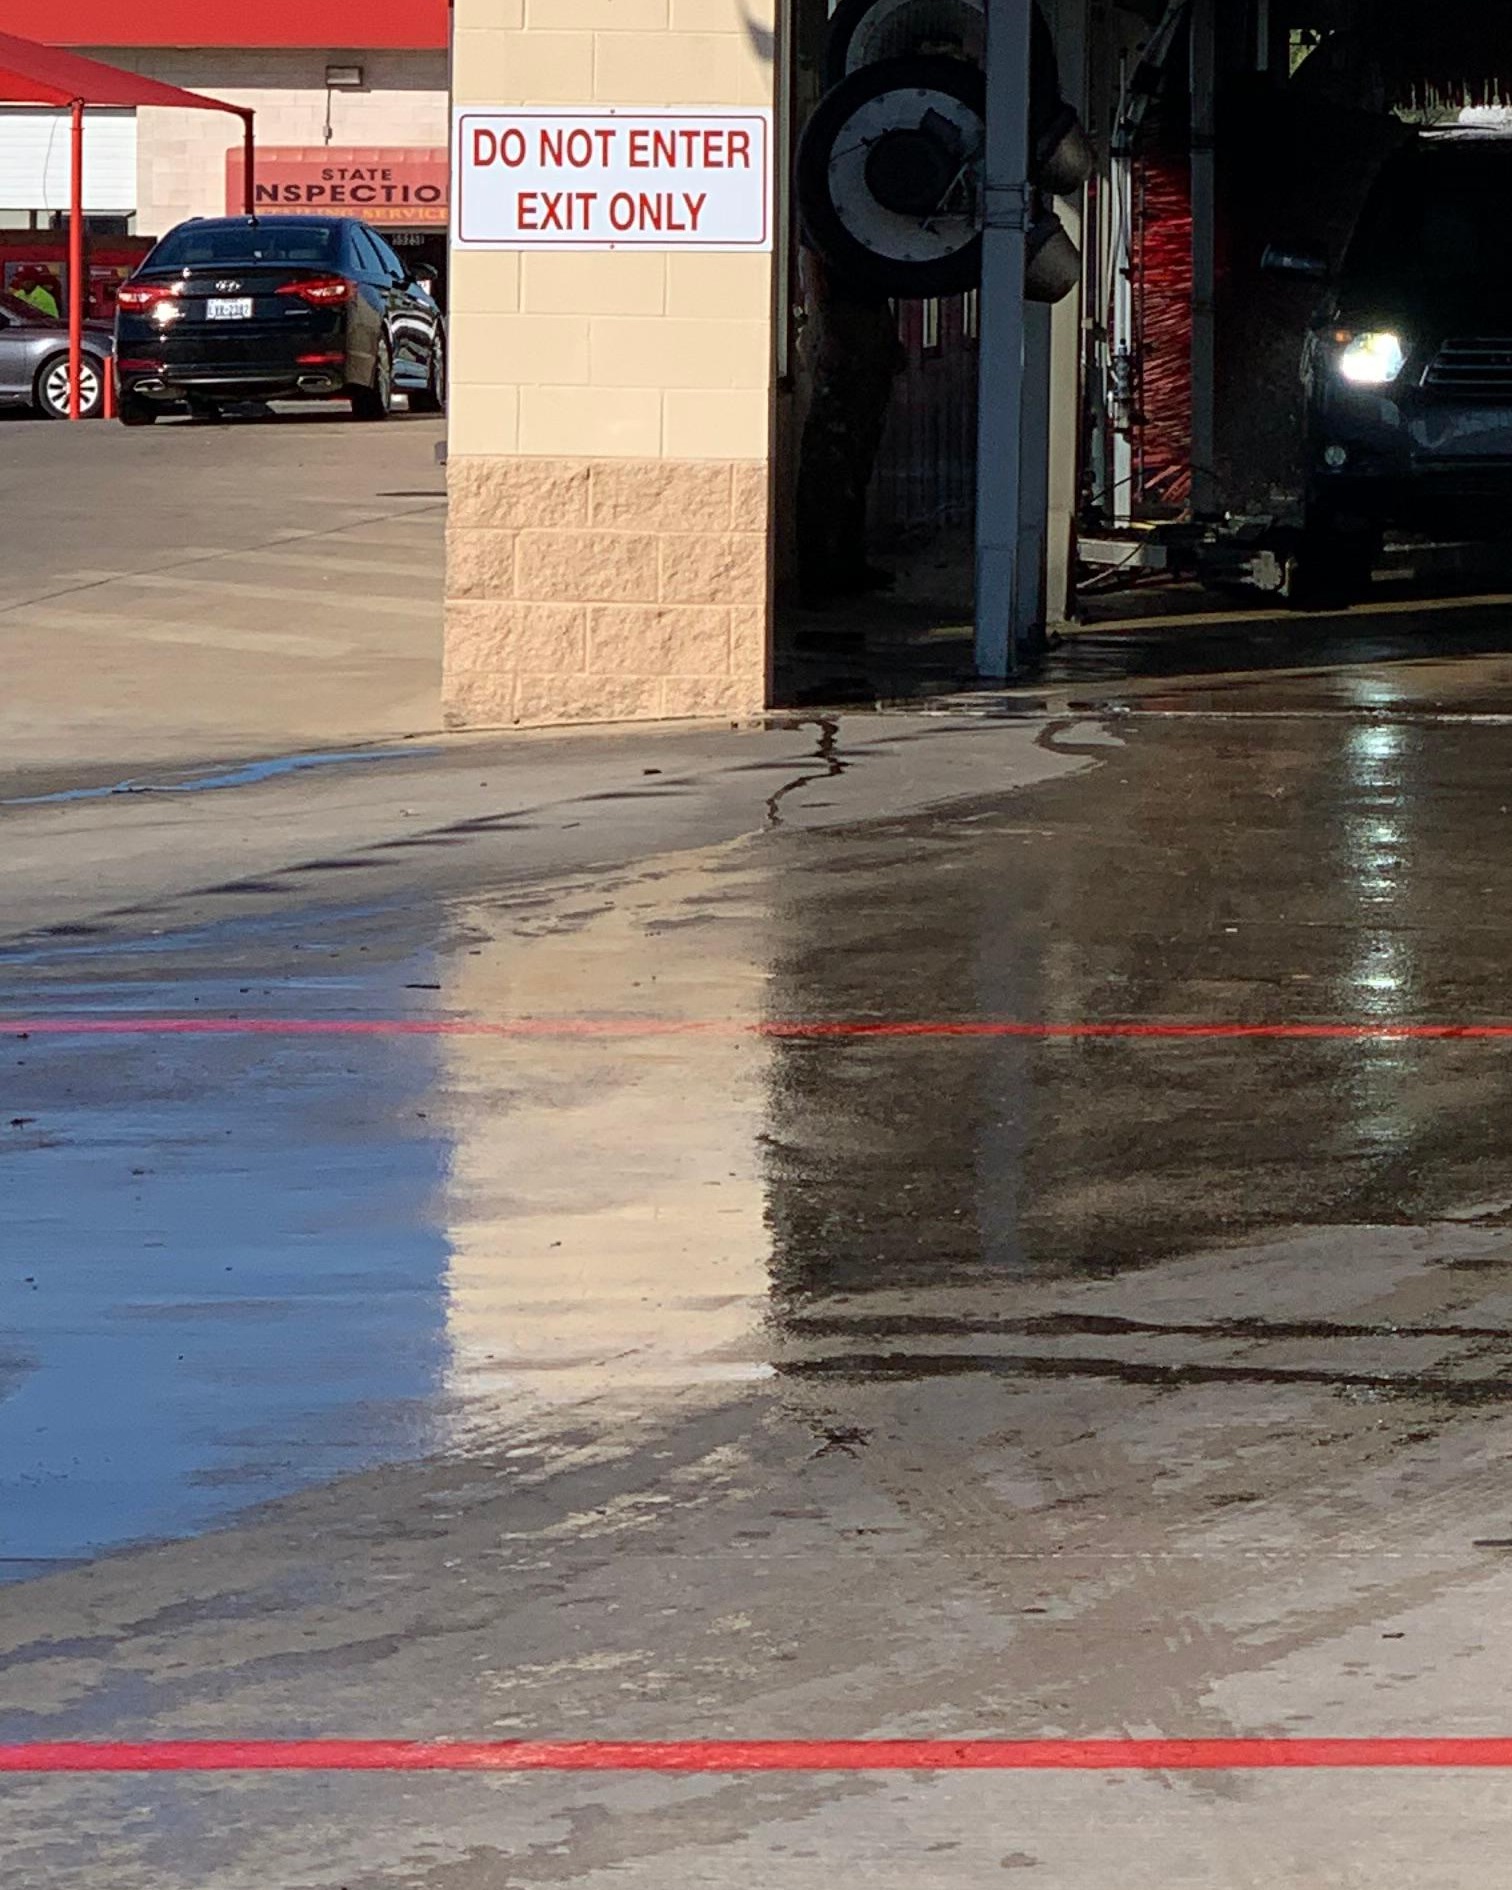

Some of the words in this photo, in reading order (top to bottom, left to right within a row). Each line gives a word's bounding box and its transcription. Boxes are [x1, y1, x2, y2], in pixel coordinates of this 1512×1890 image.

[473, 128, 526, 167] DO
[540, 129, 616, 167] NOT
[629, 130, 750, 168] ENTER
[321, 168, 393, 182] STATE
[517, 192, 598, 230] EXIT
[609, 192, 707, 231] ONLY
